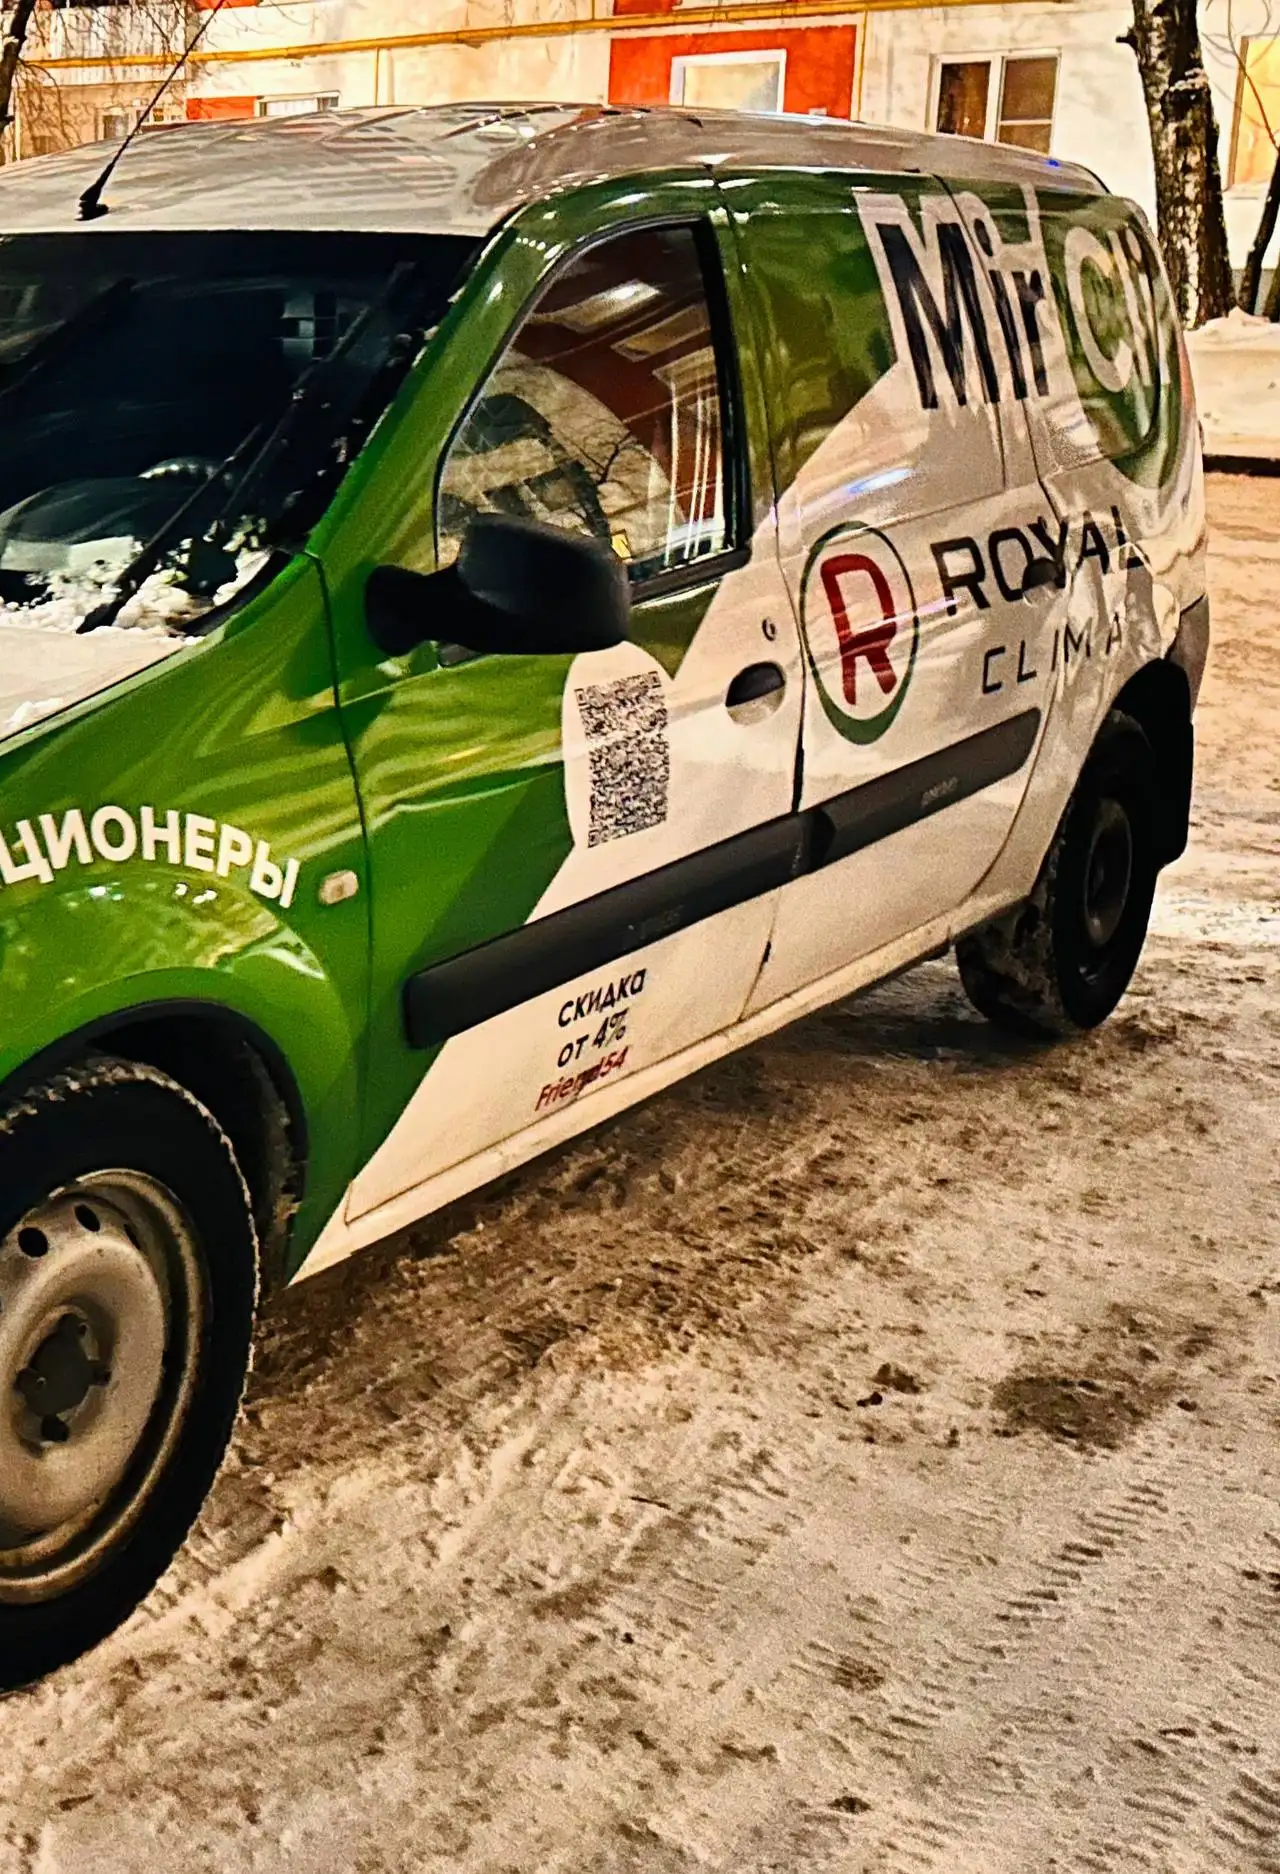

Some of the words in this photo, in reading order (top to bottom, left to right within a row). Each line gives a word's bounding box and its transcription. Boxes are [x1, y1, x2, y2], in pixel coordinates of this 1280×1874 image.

[875, 218, 1050, 409] Mir
[930, 505, 1150, 616] ROYAL
[821, 553, 897, 705] R
[982, 612, 1122, 695] CLIMA
[592, 1007, 630, 1049] 4%
